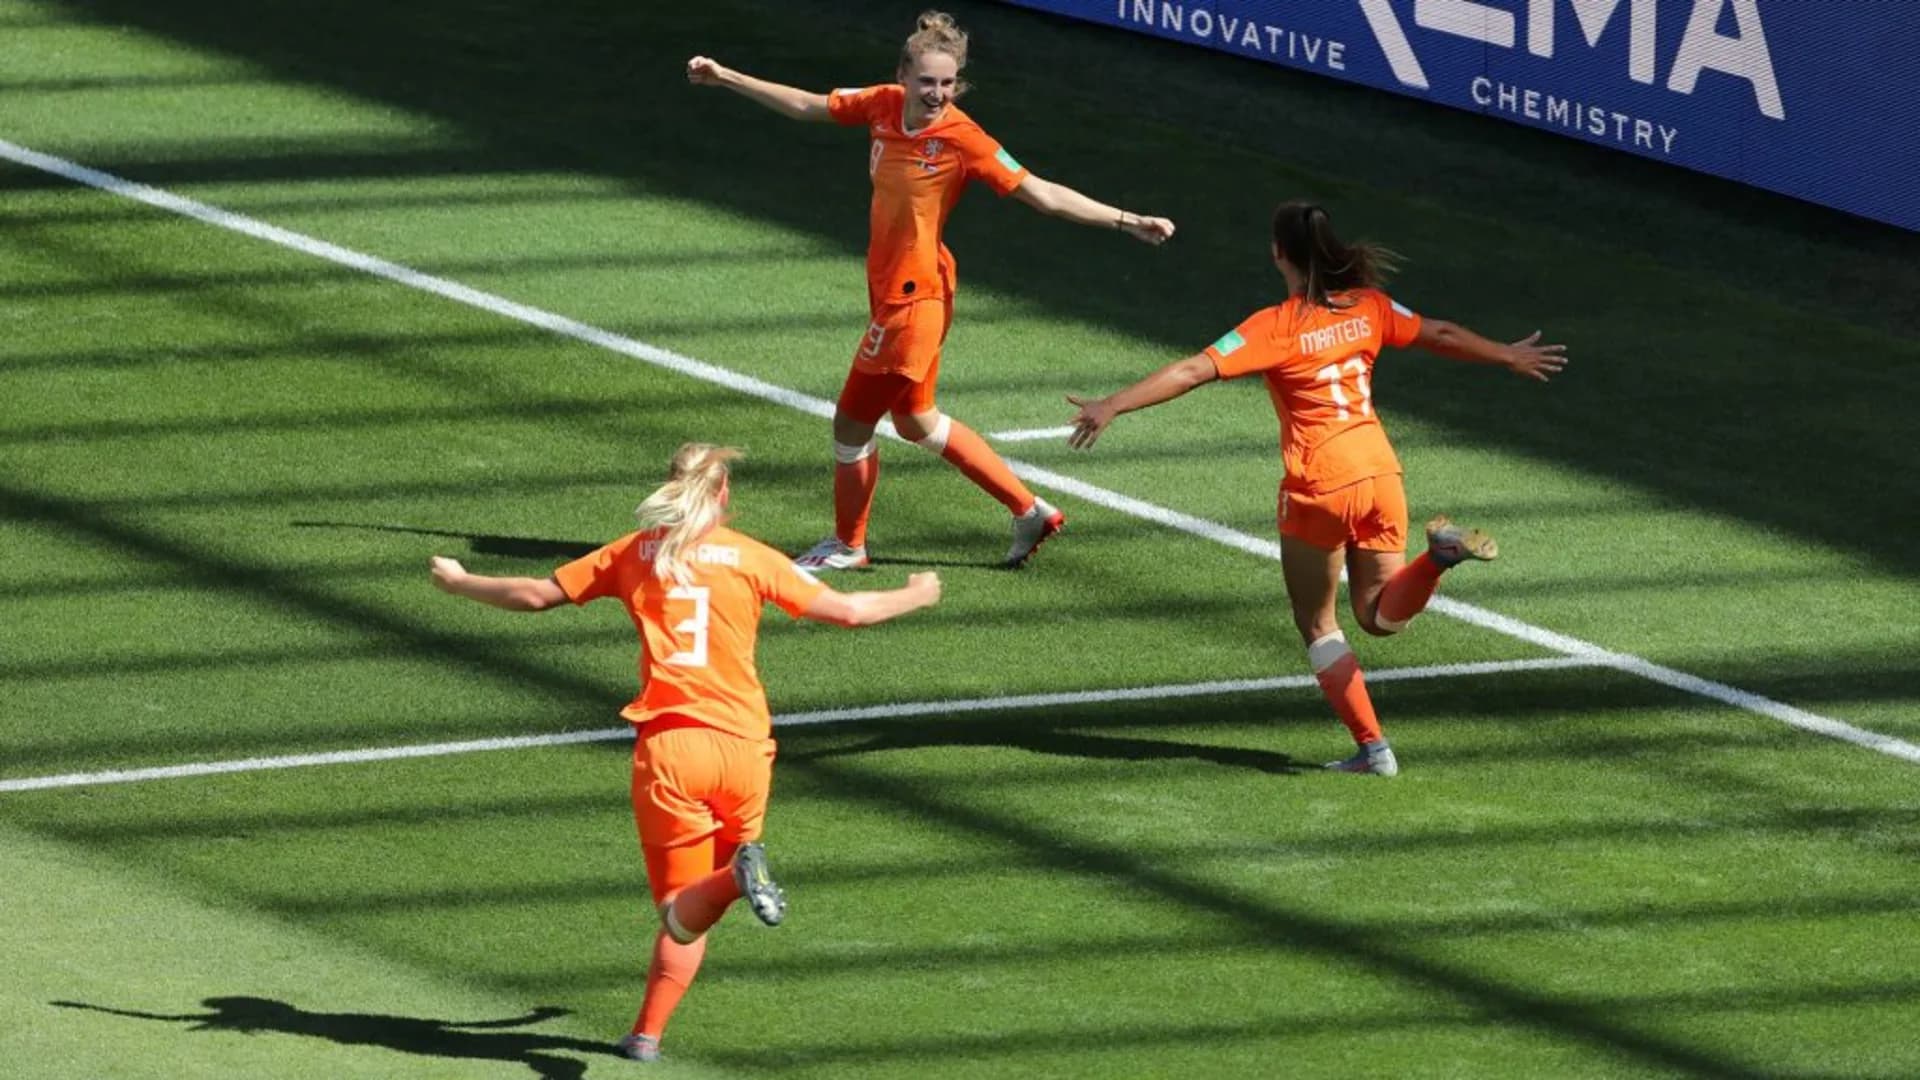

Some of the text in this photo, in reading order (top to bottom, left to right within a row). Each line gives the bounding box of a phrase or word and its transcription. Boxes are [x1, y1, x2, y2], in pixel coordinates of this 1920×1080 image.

[1118, 0, 1346, 70] INNOVATIVE
[1471, 76, 1679, 154] CHEMISTRY
[1300, 315, 1372, 355] MARTENS
[1315, 354, 1371, 421] 11
[664, 586, 710, 667] 3
